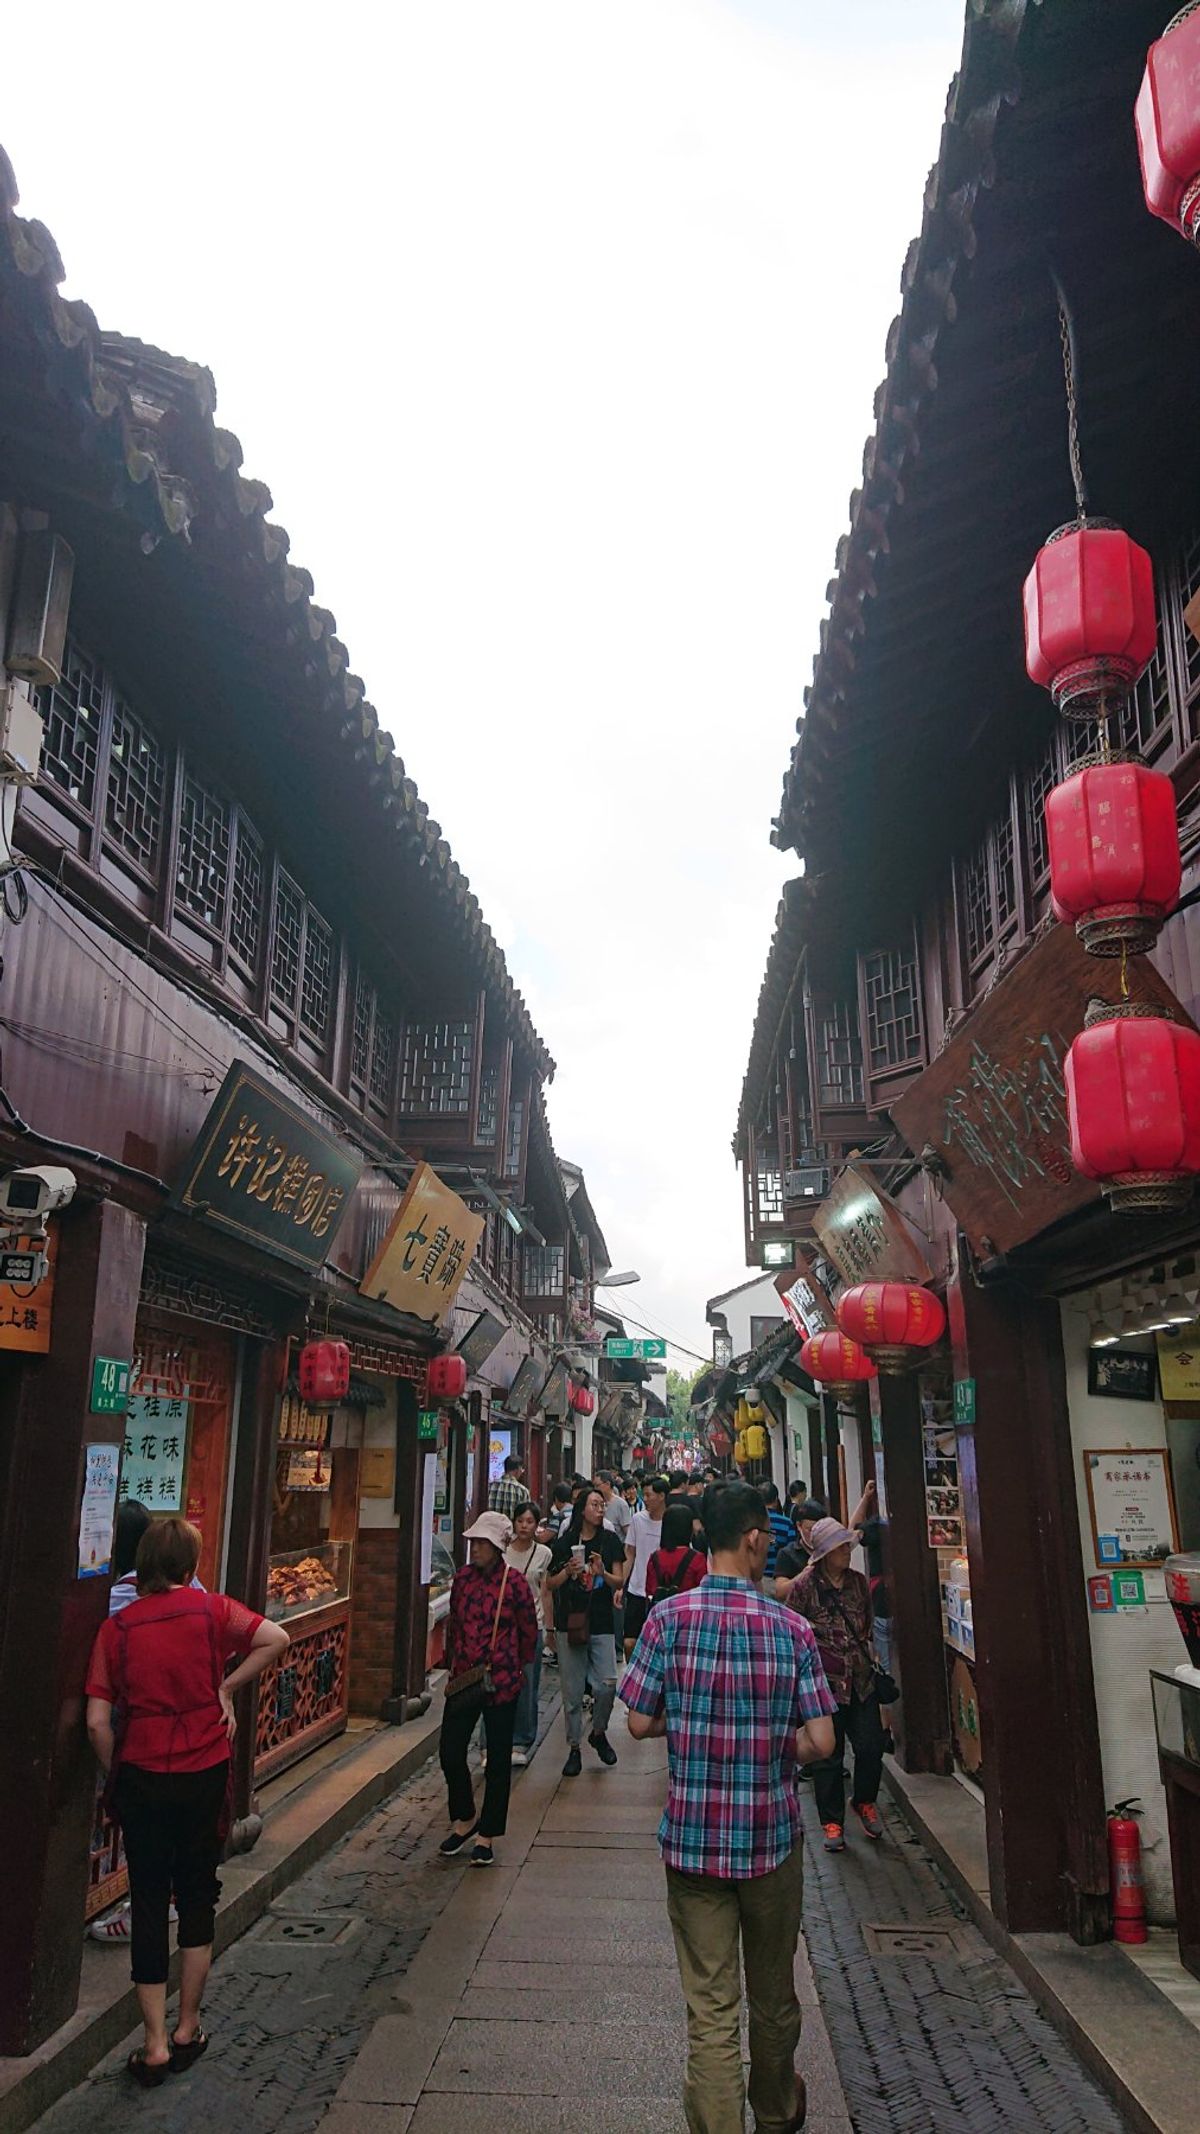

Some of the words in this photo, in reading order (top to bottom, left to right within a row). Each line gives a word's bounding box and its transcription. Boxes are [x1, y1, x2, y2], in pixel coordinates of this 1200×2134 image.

[217, 1114, 344, 1238] 许记糕团店
[0, 1306, 39, 1331] 上楼
[101, 1363, 116, 1393] 48
[158, 1397, 183, 1501] 原味糕
